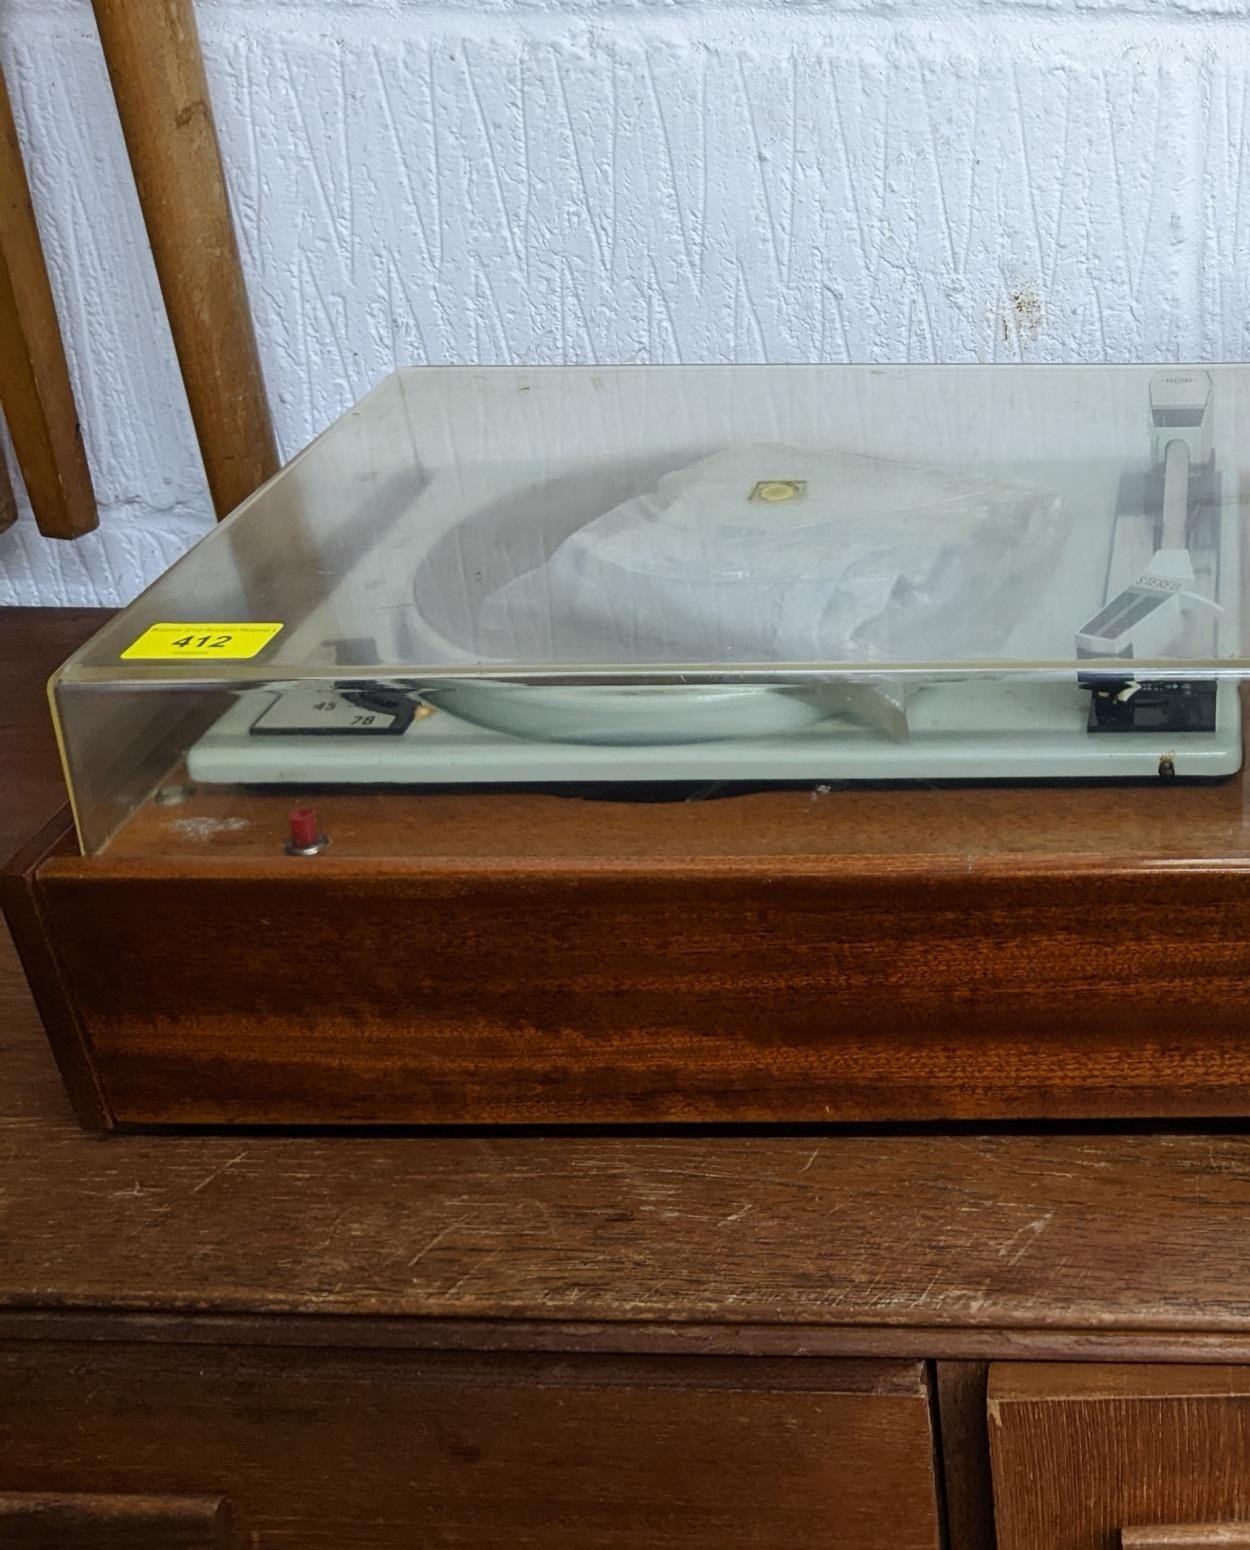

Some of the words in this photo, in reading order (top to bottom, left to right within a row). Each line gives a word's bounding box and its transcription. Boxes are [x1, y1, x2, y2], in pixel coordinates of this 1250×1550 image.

[171, 635, 233, 648] 412
[312, 702, 337, 711] 45
[350, 715, 376, 725] 78
